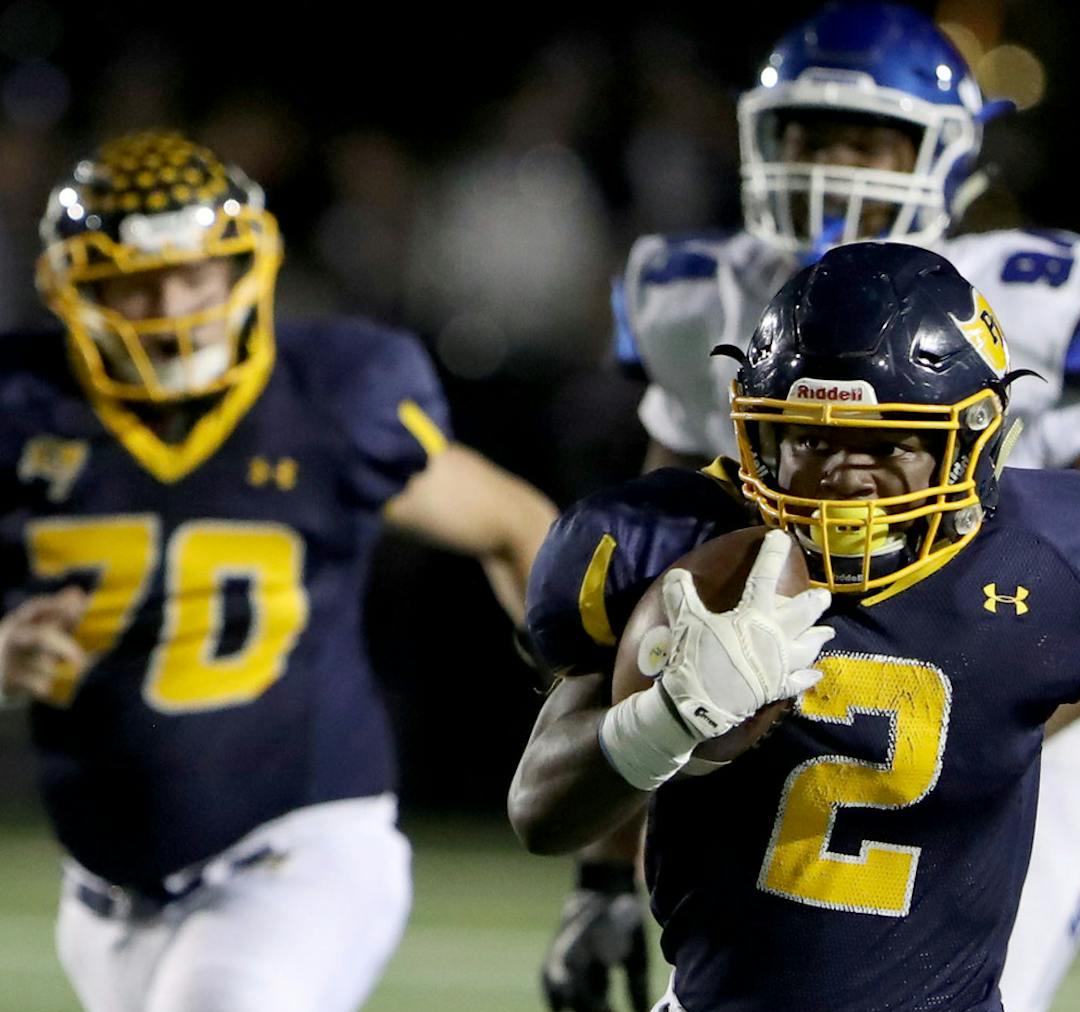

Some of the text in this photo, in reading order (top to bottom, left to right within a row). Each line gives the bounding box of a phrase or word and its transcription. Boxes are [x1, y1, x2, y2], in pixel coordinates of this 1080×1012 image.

[797, 385, 863, 401] Riddell
[25, 512, 309, 715] 70
[757, 651, 953, 918] 2
